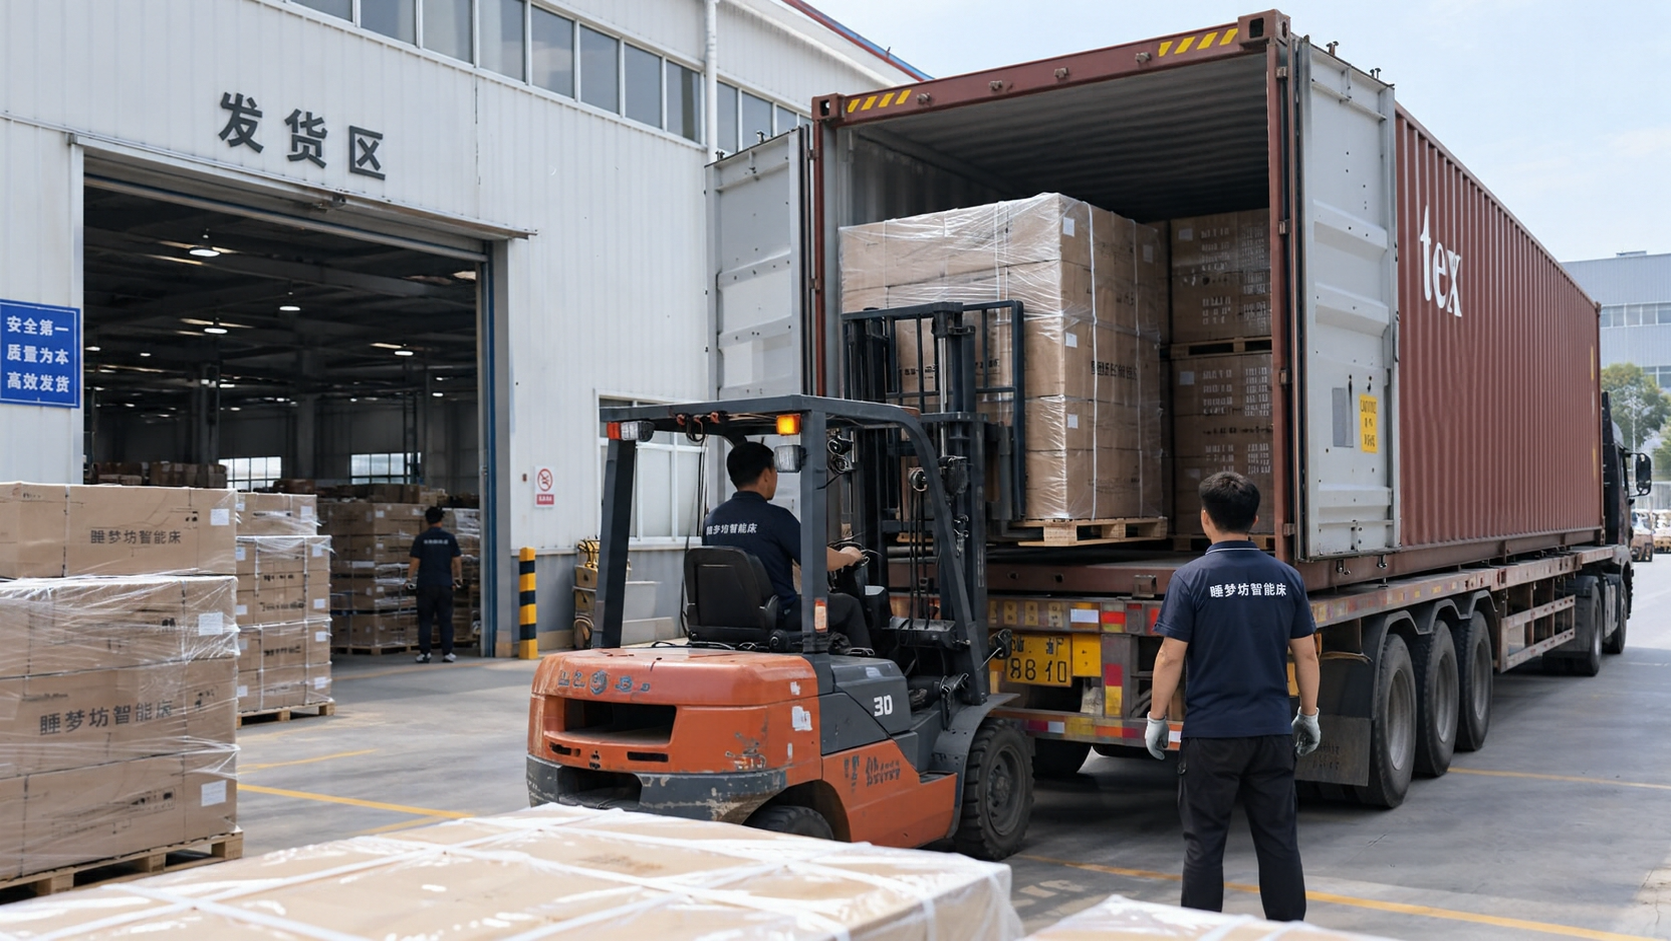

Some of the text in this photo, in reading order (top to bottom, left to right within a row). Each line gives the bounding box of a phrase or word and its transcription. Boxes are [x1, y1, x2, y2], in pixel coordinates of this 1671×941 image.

[218, 92, 386, 181] 发货区
[1420, 205, 1462, 318] tex
[7, 315, 69, 336] 安全第一
[7, 344, 69, 365] 质量为本
[7, 371, 70, 393] 高效发货
[1209, 582, 1287, 598] 睡梦坊智能床
[873, 694, 893, 717] 30
[40, 700, 173, 736] 睡梦坊智能床
